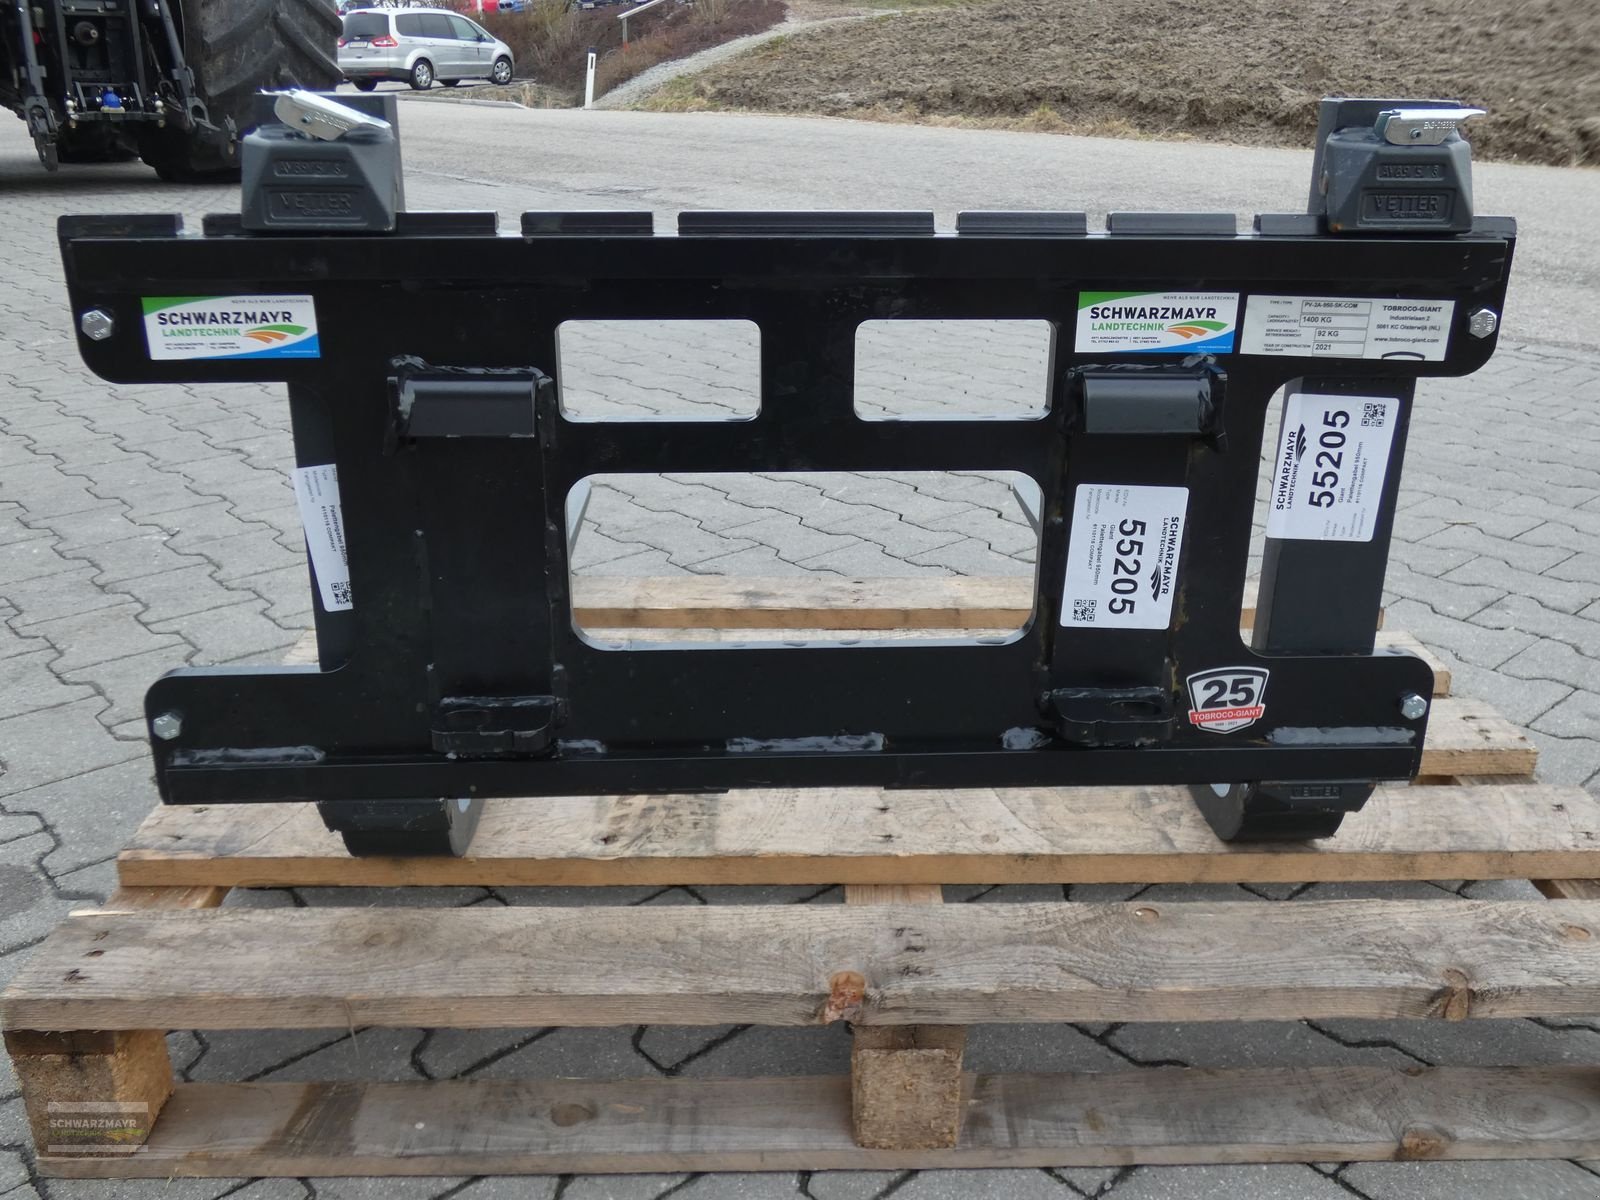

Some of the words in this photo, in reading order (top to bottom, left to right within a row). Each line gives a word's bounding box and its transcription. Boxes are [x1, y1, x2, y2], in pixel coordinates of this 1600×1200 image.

[280, 192, 351, 208] VETTER
[1375, 195, 1440, 211] VETTER
[157, 311, 293, 326] SCHWARZMAYR
[1090, 306, 1217, 320] SCHWARZMAYR
[1091, 322, 1165, 331] LANDTECHNIK
[161, 328, 241, 337] LANDTECHNIK
[1276, 431, 1297, 510] SCHWARZMAYR
[1308, 410, 1350, 508] 55205
[1286, 463, 1299, 509] LANDTECHNIK
[1338, 487, 1346, 503] Giant
[1347, 465, 1358, 503] Palettengabel
[329, 504, 344, 545] Palettengabel
[1157, 517, 1169, 564] LANDTECHNIK
[1096, 524, 1106, 564] Palettengabel
[1161, 516, 1179, 595] SCHWARZMAYR
[1108, 518, 1147, 615] 55205
[1201, 677, 1255, 709] 25
[1193, 709, 1261, 721] TOBROCO-GIANT
